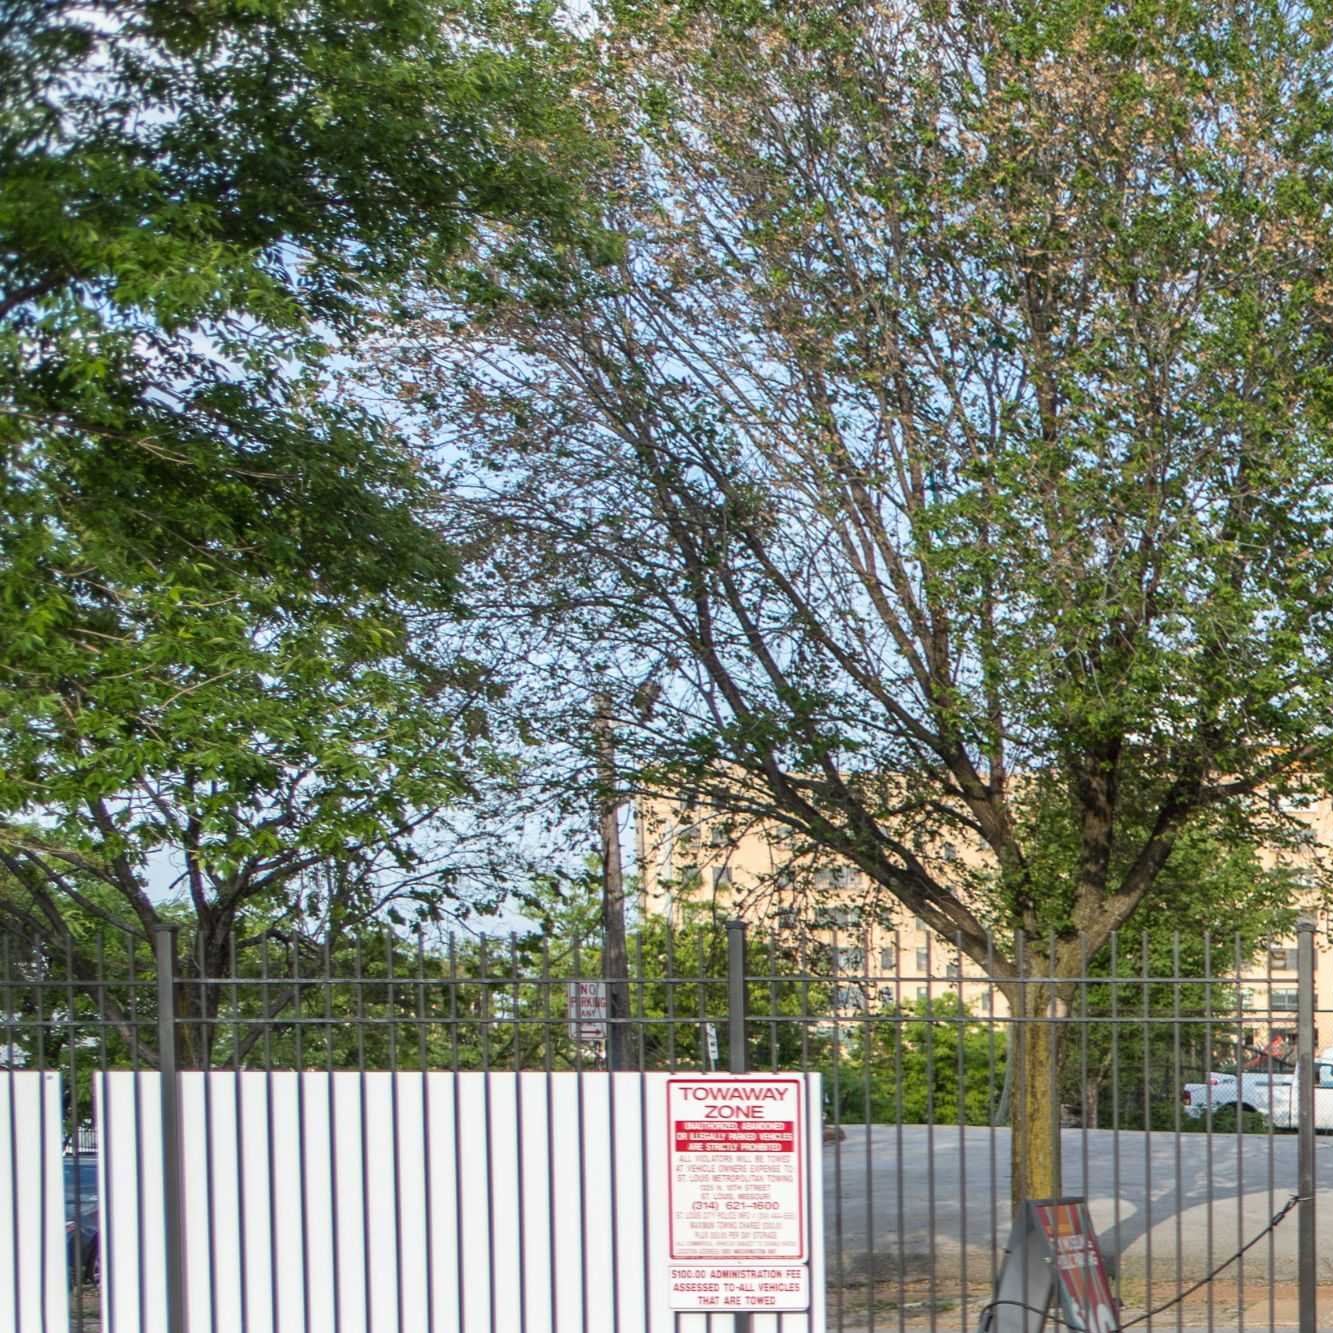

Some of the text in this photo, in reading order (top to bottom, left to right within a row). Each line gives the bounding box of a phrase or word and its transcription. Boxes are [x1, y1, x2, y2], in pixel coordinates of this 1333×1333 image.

[579, 984, 595, 995] NO
[569, 998, 607, 1008] PRKING
[679, 1087, 789, 1101] TOWAWAY
[704, 1105, 765, 1119] ZONE
[692, 1201, 720, 1211] (314)
[710, 1269, 783, 1279] ADMINISTRATION
[786, 1269, 801, 1279] FEE
[673, 1283, 721, 1292] ASSESSED
[758, 1283, 801, 1292] VEHICLES
[697, 1296, 776, 1305] THAT ARE TOWED
